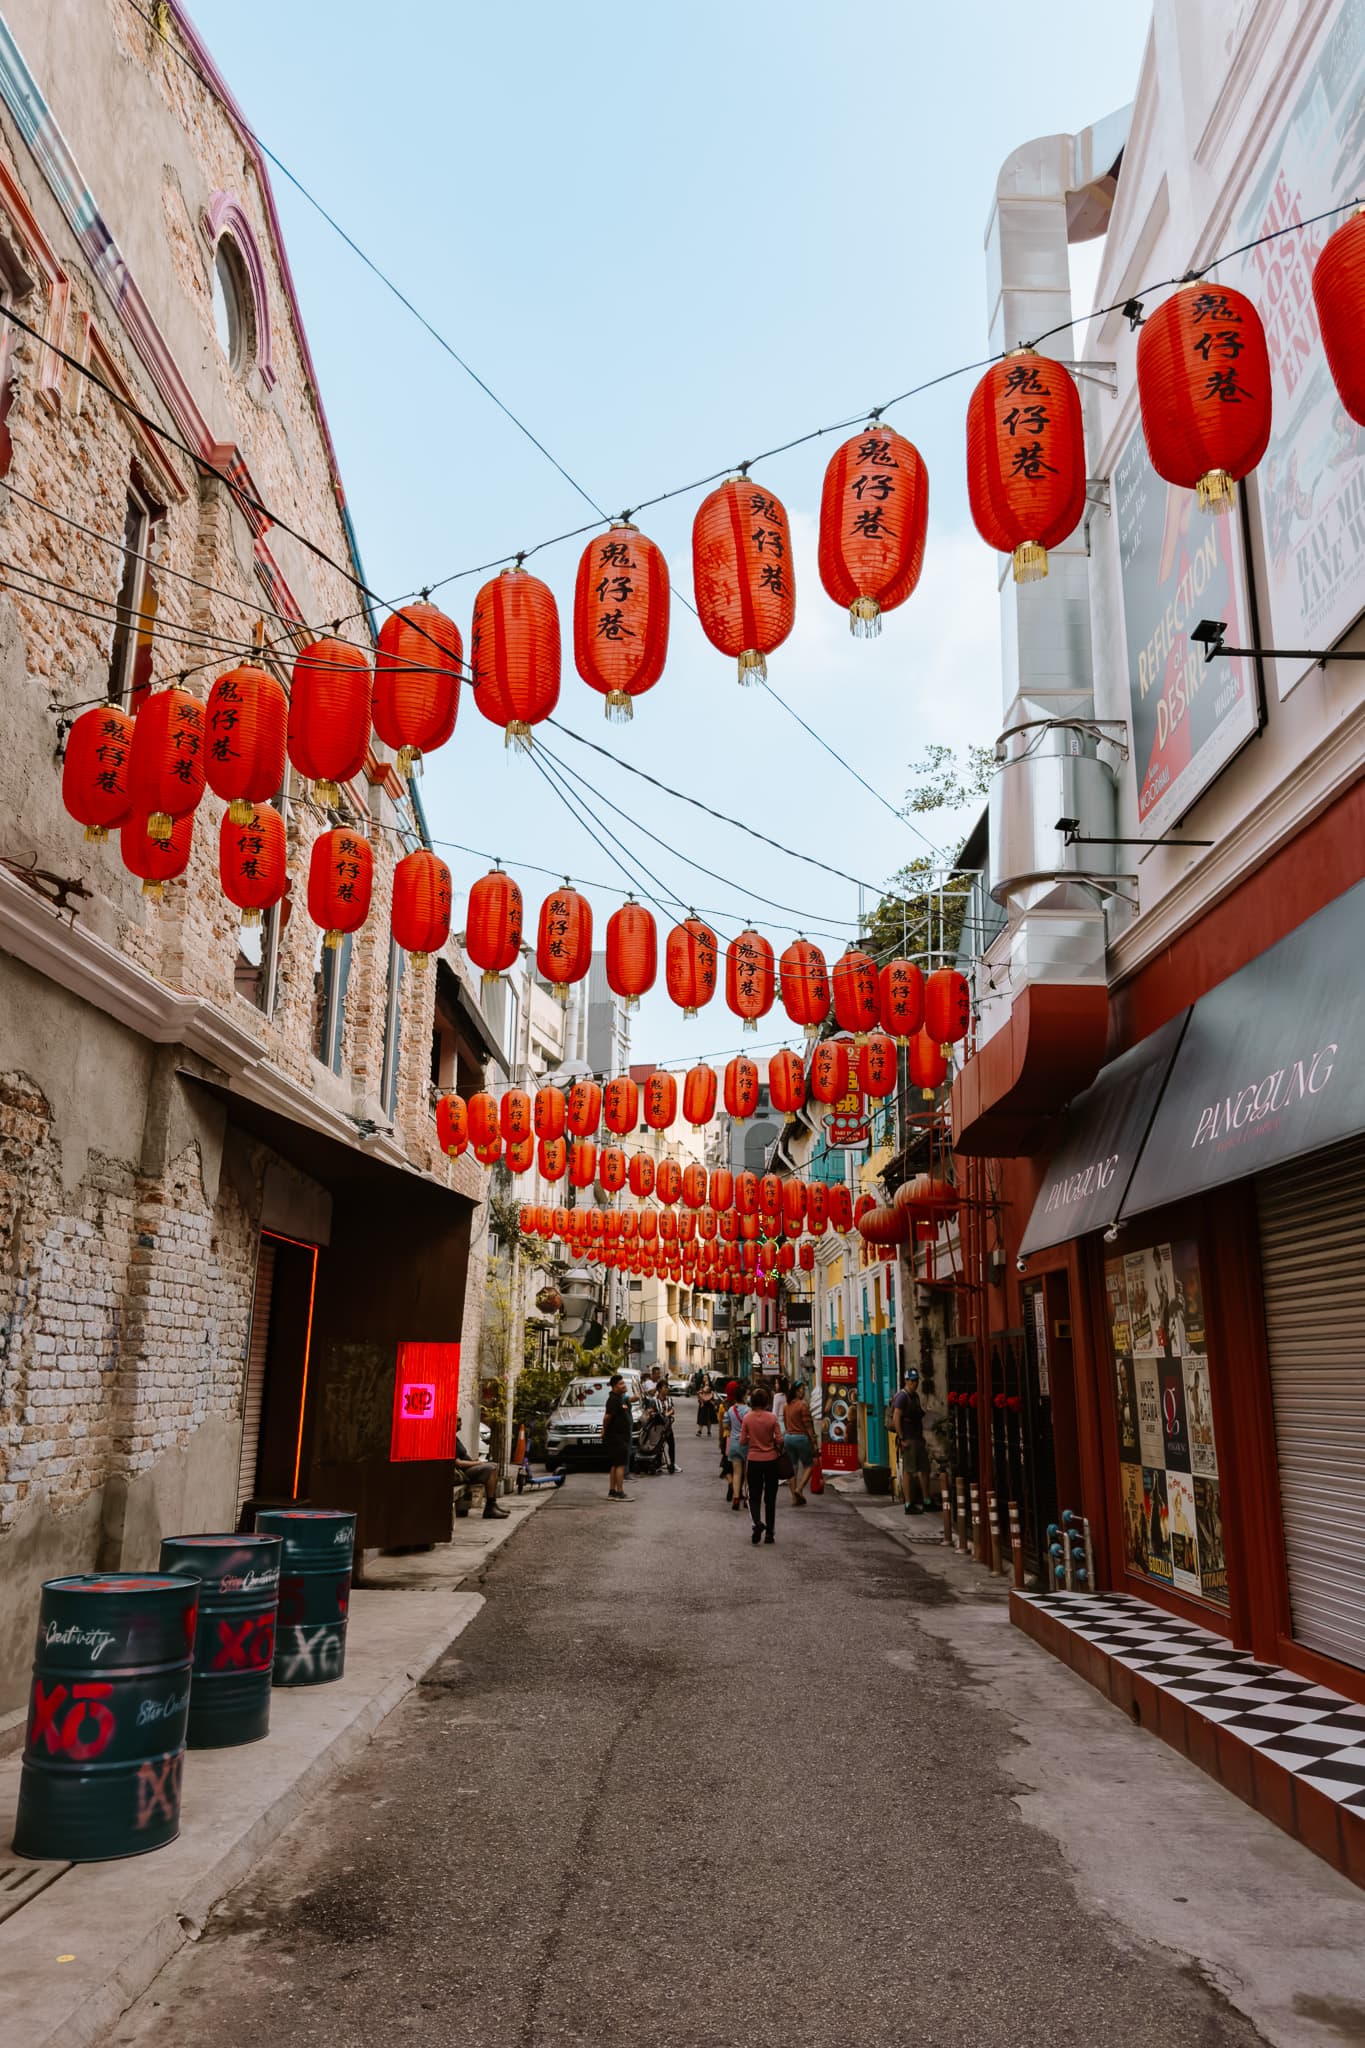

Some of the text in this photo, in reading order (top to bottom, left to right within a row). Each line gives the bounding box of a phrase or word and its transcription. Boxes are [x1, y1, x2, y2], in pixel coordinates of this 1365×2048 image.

[1191, 292, 1255, 403] 鬼仔巷
[1002, 366, 1059, 479] 鬼仔巷
[852, 438, 899, 540] 鬼仔巷
[749, 493, 790, 597] 鬼仔巷
[596, 542, 636, 640] 鬼仔巷
[1138, 522, 1217, 702] REFLECTION
[96, 720, 129, 794] 鬼仔巷
[168, 704, 200, 785] 鬼仔巷
[211, 681, 243, 762] 鬼仔巷
[336, 839, 363, 903] 鬼仔巷
[548, 900, 570, 958] 鬼仔巷
[698, 932, 714, 986] 鬼仔巷
[738, 943, 760, 997] 鬼仔巷
[892, 968, 912, 1017] 鬼仔巷
[46, 1620, 117, 1661] Creativity
